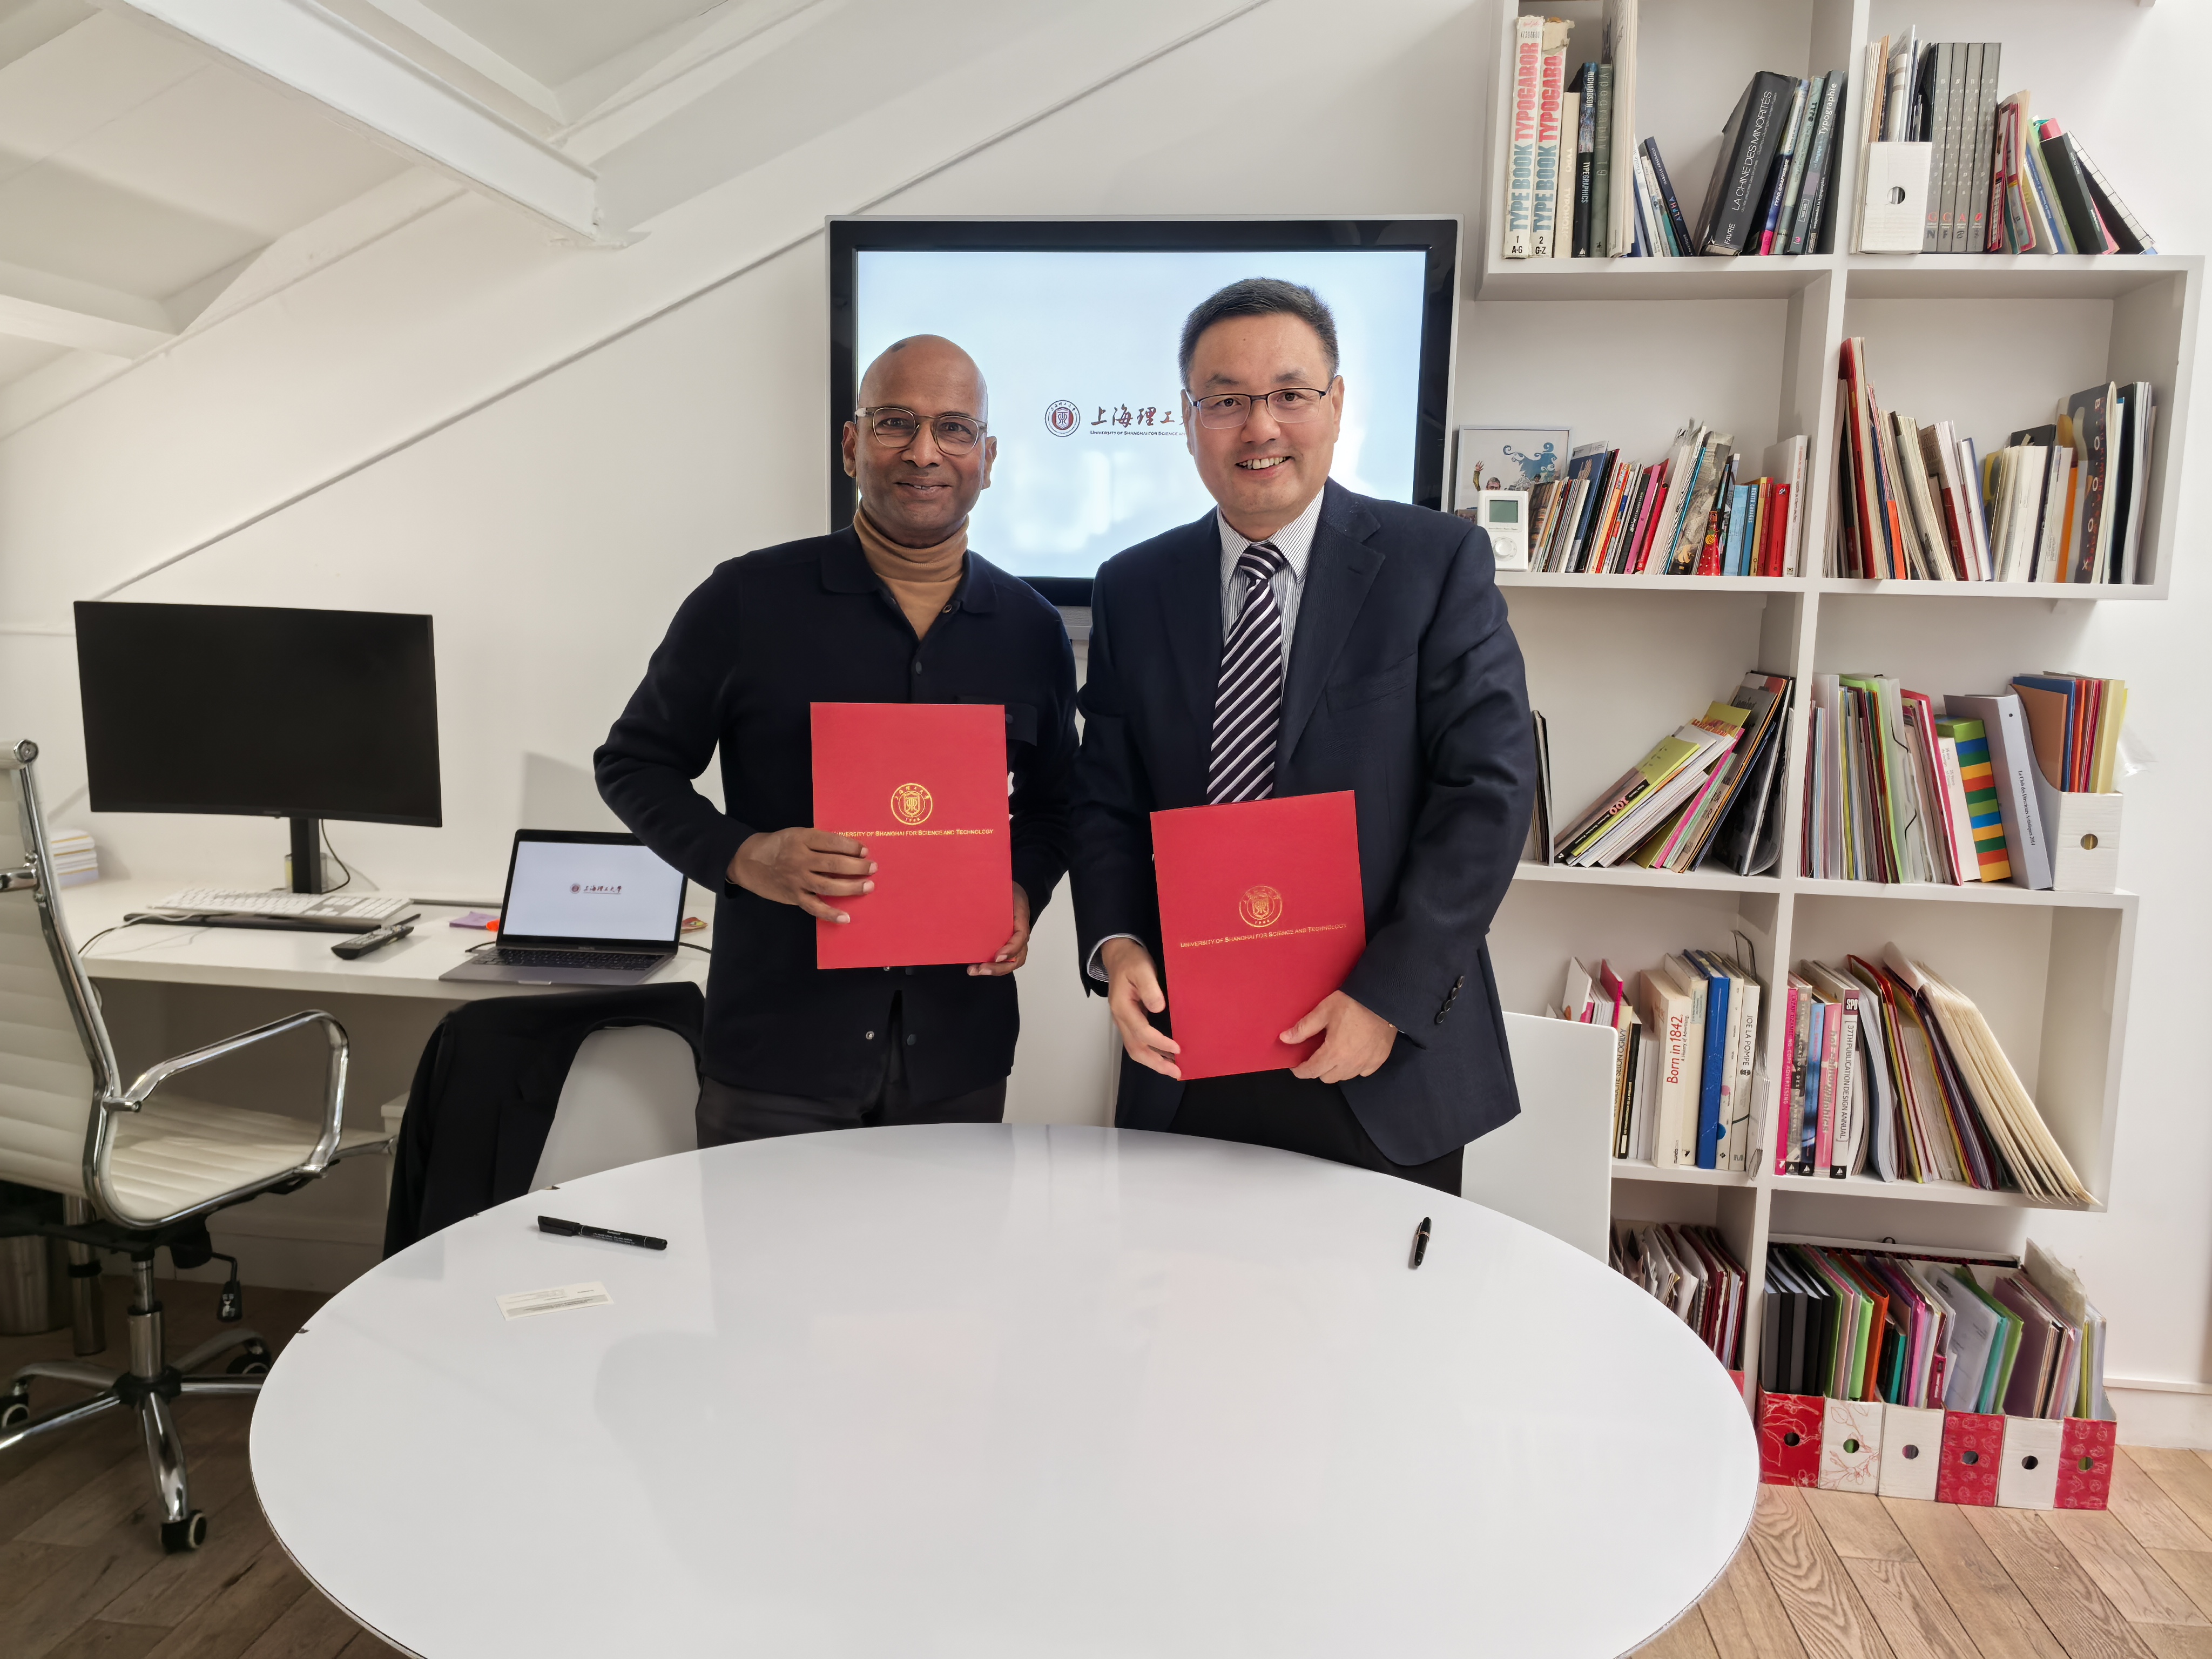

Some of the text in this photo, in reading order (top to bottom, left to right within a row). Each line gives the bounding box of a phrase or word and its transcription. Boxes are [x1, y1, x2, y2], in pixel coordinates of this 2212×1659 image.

[1514, 42, 1539, 142] TYPOGABOR
[1820, 82, 1838, 136] Typographie
[1533, 52, 1563, 232] TYPE BOOK TYPOGABO
[1512, 143, 1533, 190] BOOK
[1732, 196, 1742, 211] LA
[1738, 166, 1752, 197] CHINE
[1746, 144, 1758, 166] DES
[1580, 161, 1590, 203] TYPEGRAPHICS
[1510, 192, 1530, 232] TYPE
[1724, 223, 1736, 245] FAVRE
[1511, 246, 1523, 254] A-G
[1535, 246, 1546, 254] G-Z
[1091, 403, 1184, 428] 上海理工
[1609, 796, 1630, 815] 100
[1180, 939, 1215, 948] UNIVERSITY
[1225, 935, 1255, 943] SHANGHAI
[1307, 924, 1347, 933] TECHNOLOGY
[1617, 1028, 1626, 1053] OGILVY
[1745, 1030, 1751, 1038] LA
[1670, 1044, 1680, 1054] in
[1743, 1041, 1751, 1065] POMPE
[1666, 1057, 1680, 1083] Born
[1842, 1043, 1853, 1086] PUBLICATION
[1782, 1065, 1791, 1104] ADVERTISING
[1840, 1087, 1850, 1111] DESIGN
